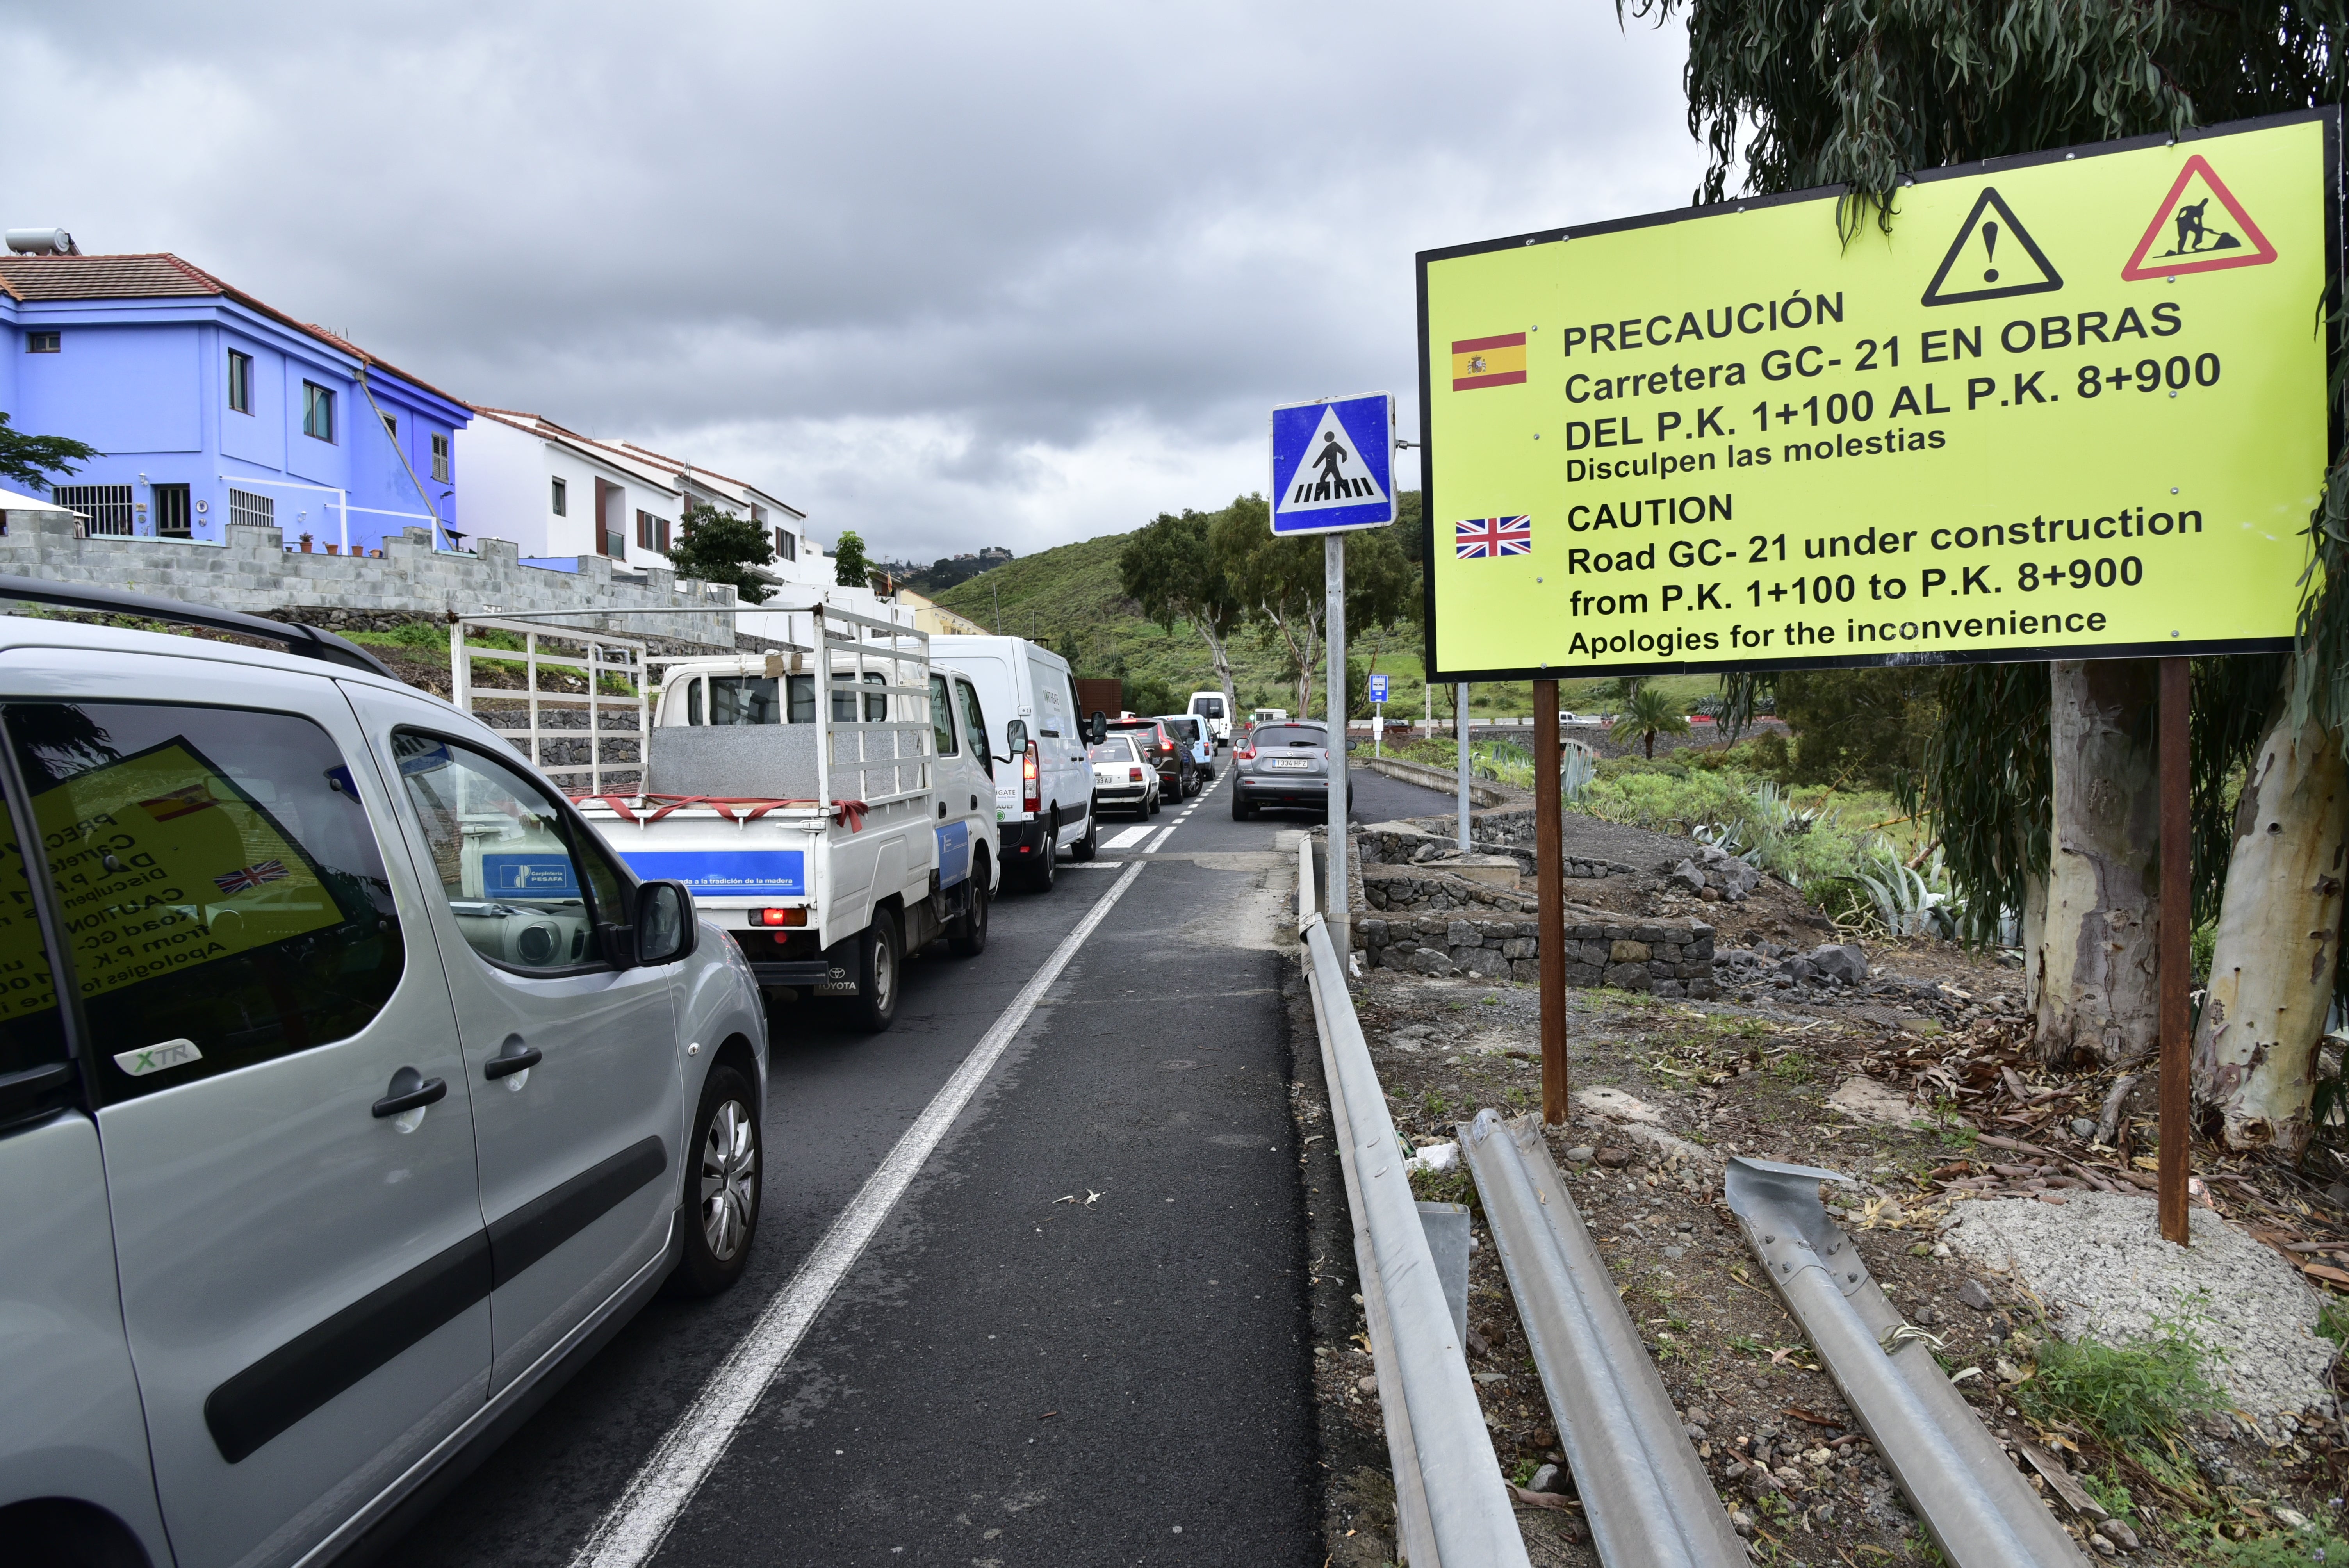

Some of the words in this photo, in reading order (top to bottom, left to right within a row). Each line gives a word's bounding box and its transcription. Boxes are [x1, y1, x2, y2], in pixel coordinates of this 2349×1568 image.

[1565, 290, 1843, 356] PRECAUCIÓN
[1566, 363, 1745, 403] Carretera
[1762, 346, 1840, 380] GC-
[1855, 336, 1898, 371] 21
[1922, 326, 1981, 363] EN
[2001, 303, 2181, 353] OBRAS
[1567, 417, 1643, 450] DEL
[1658, 406, 1734, 441] P.K.
[1753, 391, 1873, 431] 1+100
[1889, 383, 1950, 418] AL
[1968, 371, 2058, 410] P.K.
[2078, 353, 2220, 398] 8+900
[1567, 452, 1715, 482] Disculpen
[1729, 445, 1771, 467] las
[1785, 428, 1945, 462] molestias
[1568, 494, 1731, 531] CAUTION
[1569, 543, 1654, 574] Road
[1669, 539, 1736, 568] GC-
[1749, 534, 1785, 563] 21
[1805, 527, 1917, 559] under
[1931, 507, 2201, 550] construction
[1570, 591, 1647, 616] from
[1663, 583, 1731, 611] P.K.
[1747, 575, 1854, 606] 1+100
[1869, 574, 1906, 600] to
[1923, 565, 2001, 597] P.K.
[2018, 556, 2142, 591] 8+900
[1568, 627, 1718, 659] Apologies
[1730, 625, 1774, 647] for
[1785, 622, 1834, 645] the
[1848, 610, 2106, 642] inconvenience
[134, 1044, 188, 1072] XTR
